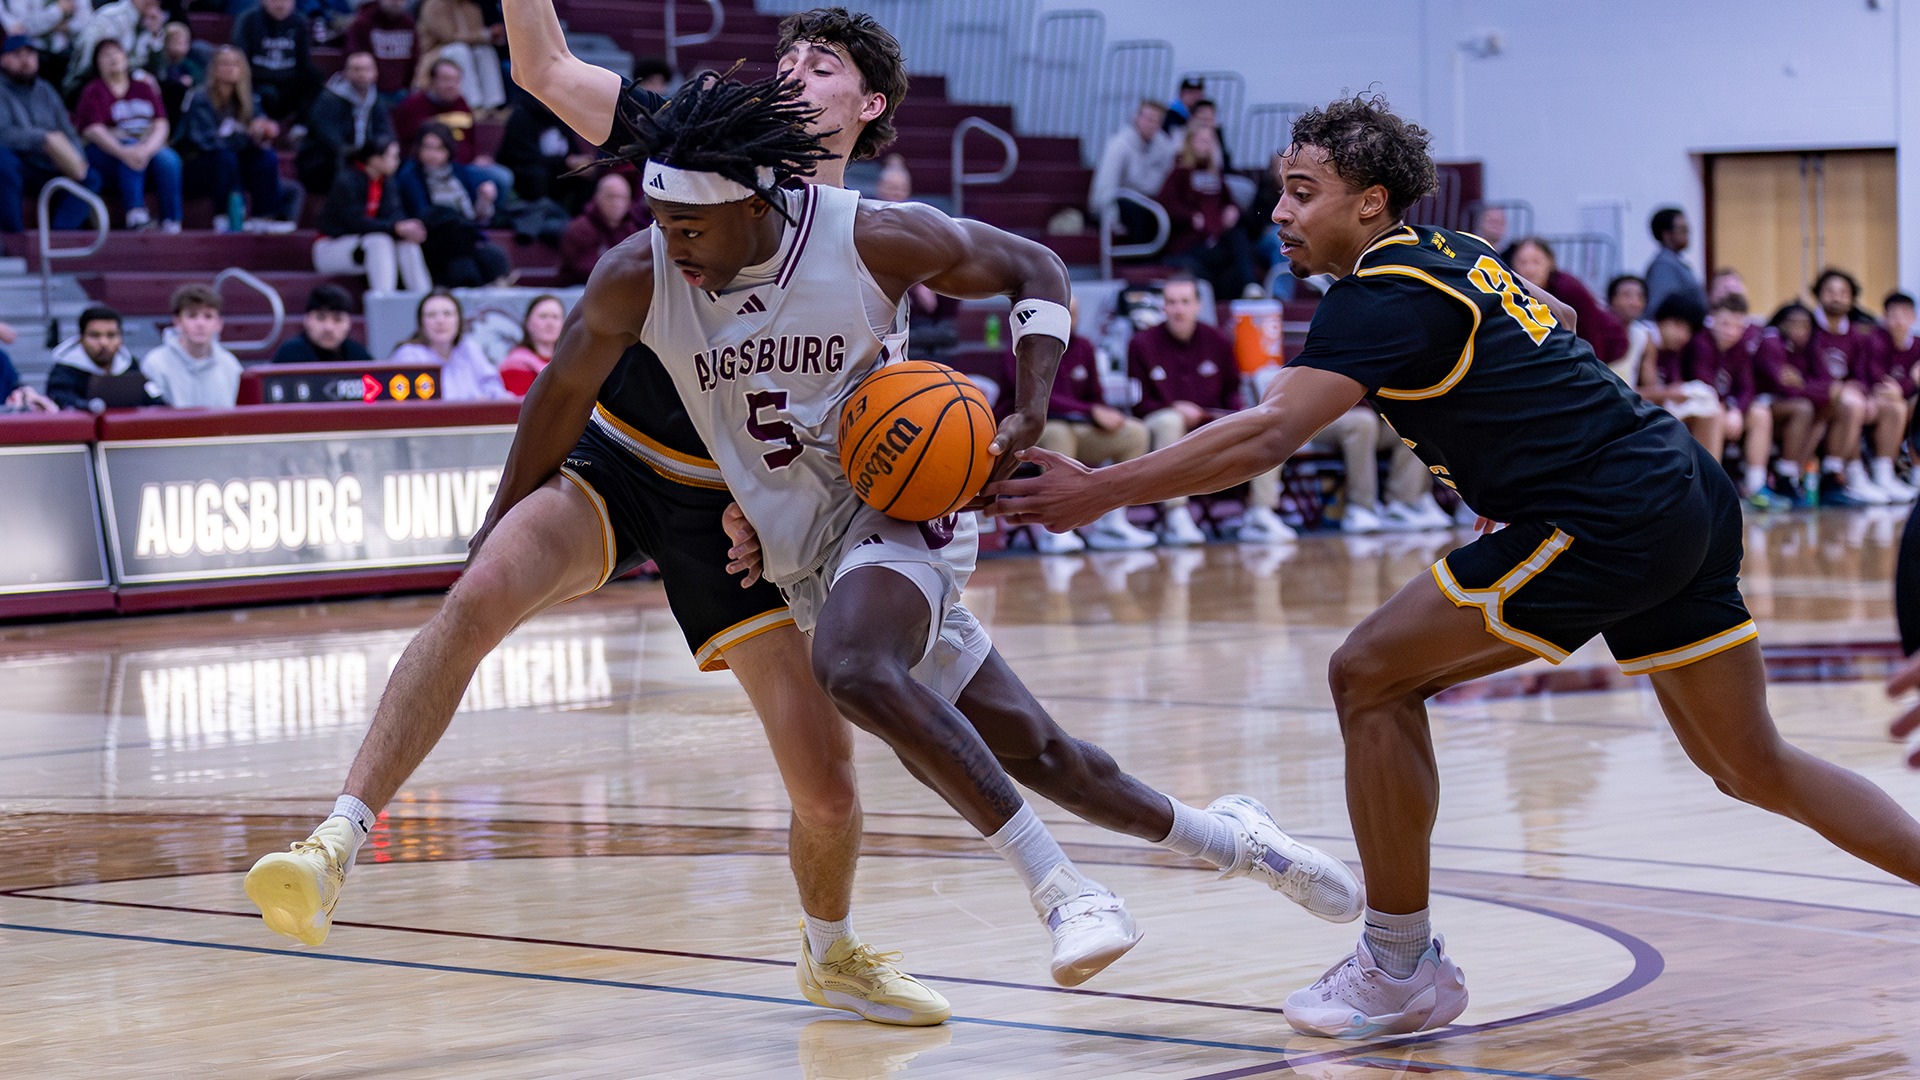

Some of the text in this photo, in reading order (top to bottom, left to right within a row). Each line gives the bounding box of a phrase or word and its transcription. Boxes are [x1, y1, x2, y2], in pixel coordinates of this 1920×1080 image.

[743, 388, 805, 473] 5
[855, 416, 924, 499] Wilson
[135, 473, 364, 559] AUGSBURG
